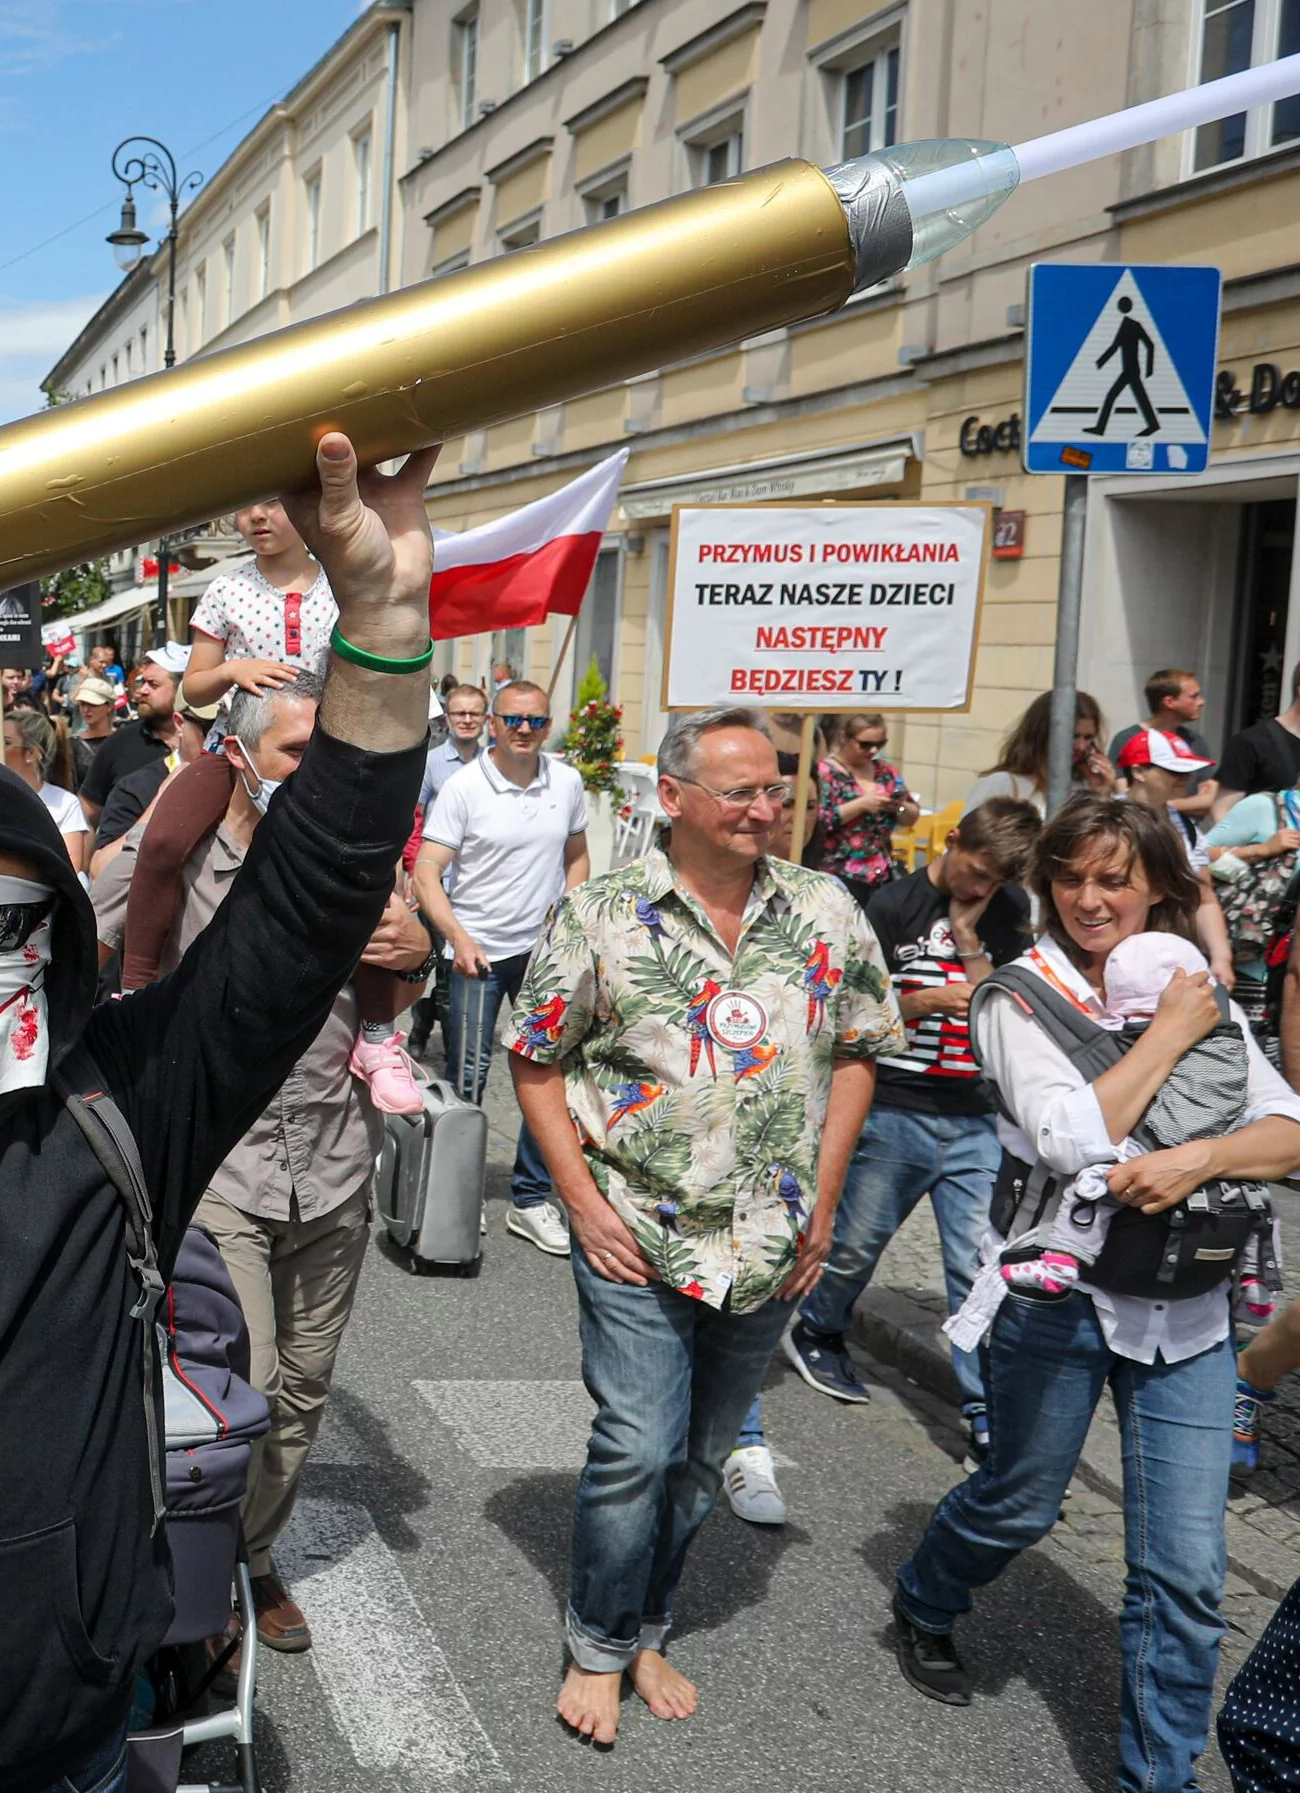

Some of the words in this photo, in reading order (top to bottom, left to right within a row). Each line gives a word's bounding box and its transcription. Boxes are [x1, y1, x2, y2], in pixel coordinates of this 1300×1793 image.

[698, 543, 803, 563] PRZYMUS
[809, 543, 816, 563] I
[821, 543, 960, 563] POWIKŁANIA
[695, 583, 774, 606] TERAZ
[780, 583, 863, 606] NASZE
[869, 583, 956, 606] DZIECI
[755, 626, 888, 654] NASTĘPNY
[730, 668, 855, 696] BĘDZIESZ
[858, 669, 889, 692] TY
